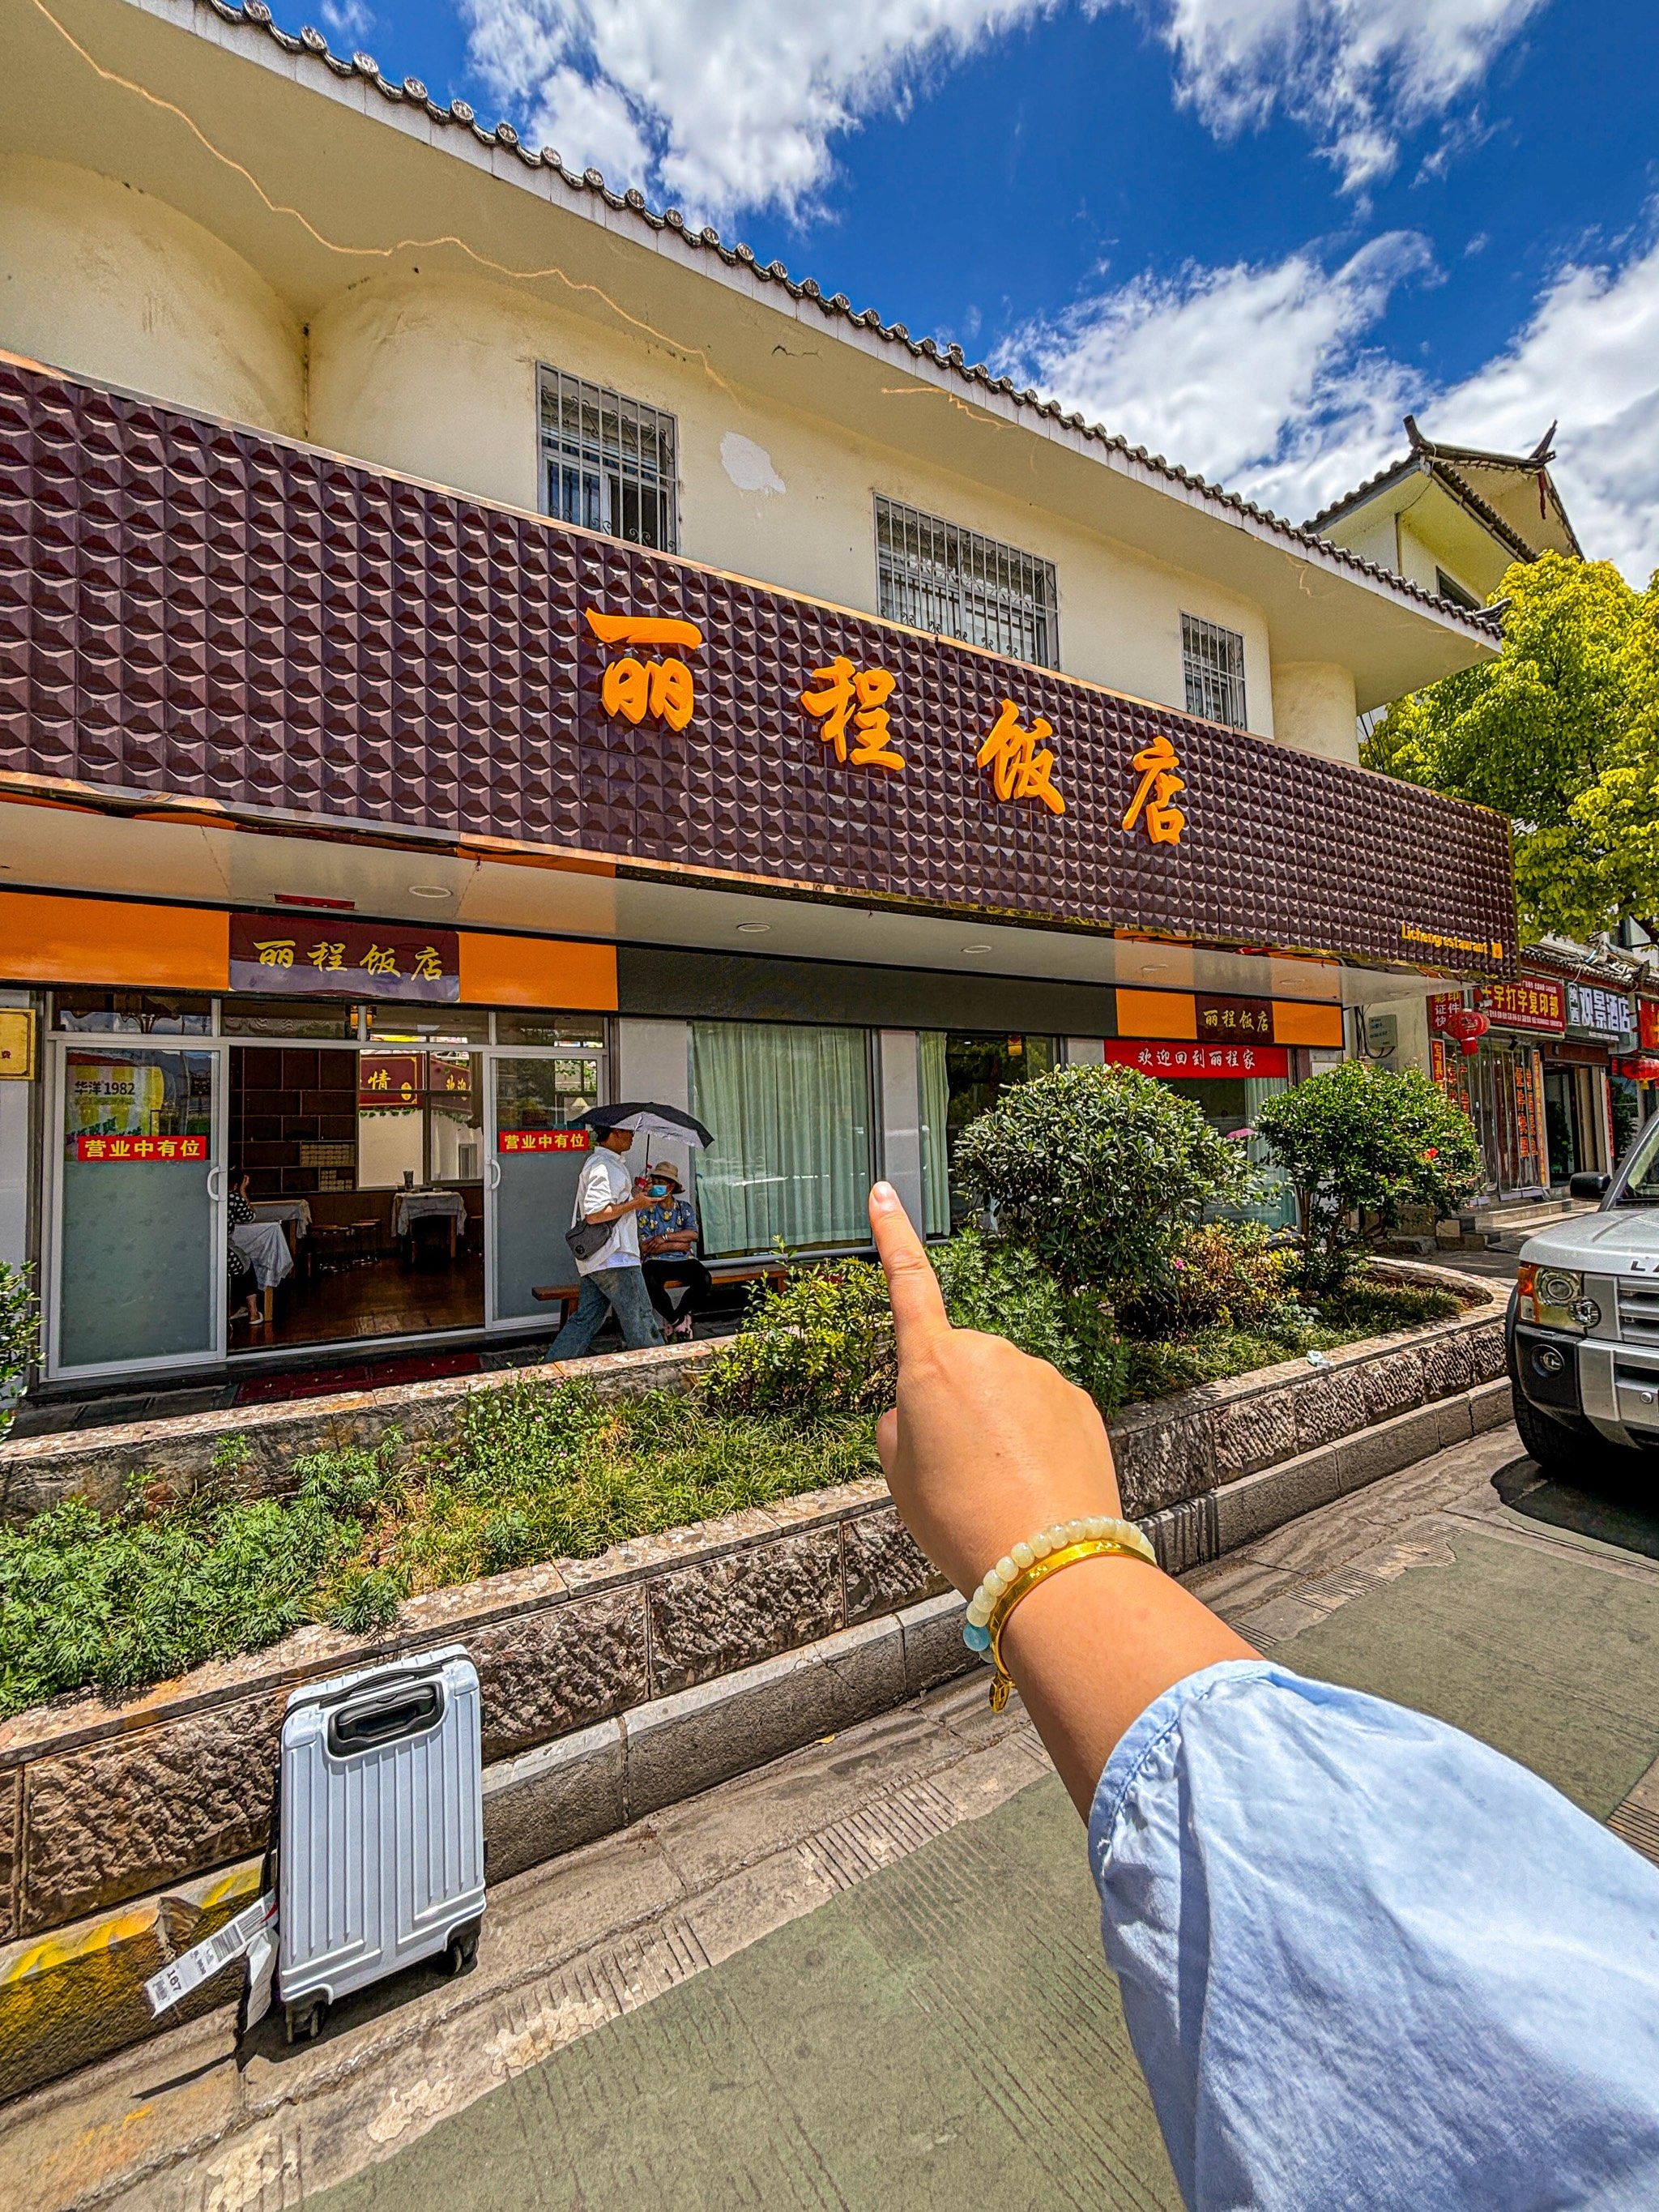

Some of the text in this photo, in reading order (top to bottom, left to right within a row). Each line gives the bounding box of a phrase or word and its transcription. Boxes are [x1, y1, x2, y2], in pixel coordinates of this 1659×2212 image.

[585, 607, 1186, 846] 丽程饭店
[253, 940, 442, 982] 丽程饭店
[1435, 1002, 1460, 1015] 证件
[1580, 986, 1630, 1032] 观景酒店
[1203, 1010, 1269, 1033] 丽程饭店
[1137, 1048, 1256, 1070] 欢迎回到丽程家
[84, 1140, 200, 1158] 营业中有位
[504, 1134, 585, 1150] 营业中有位
